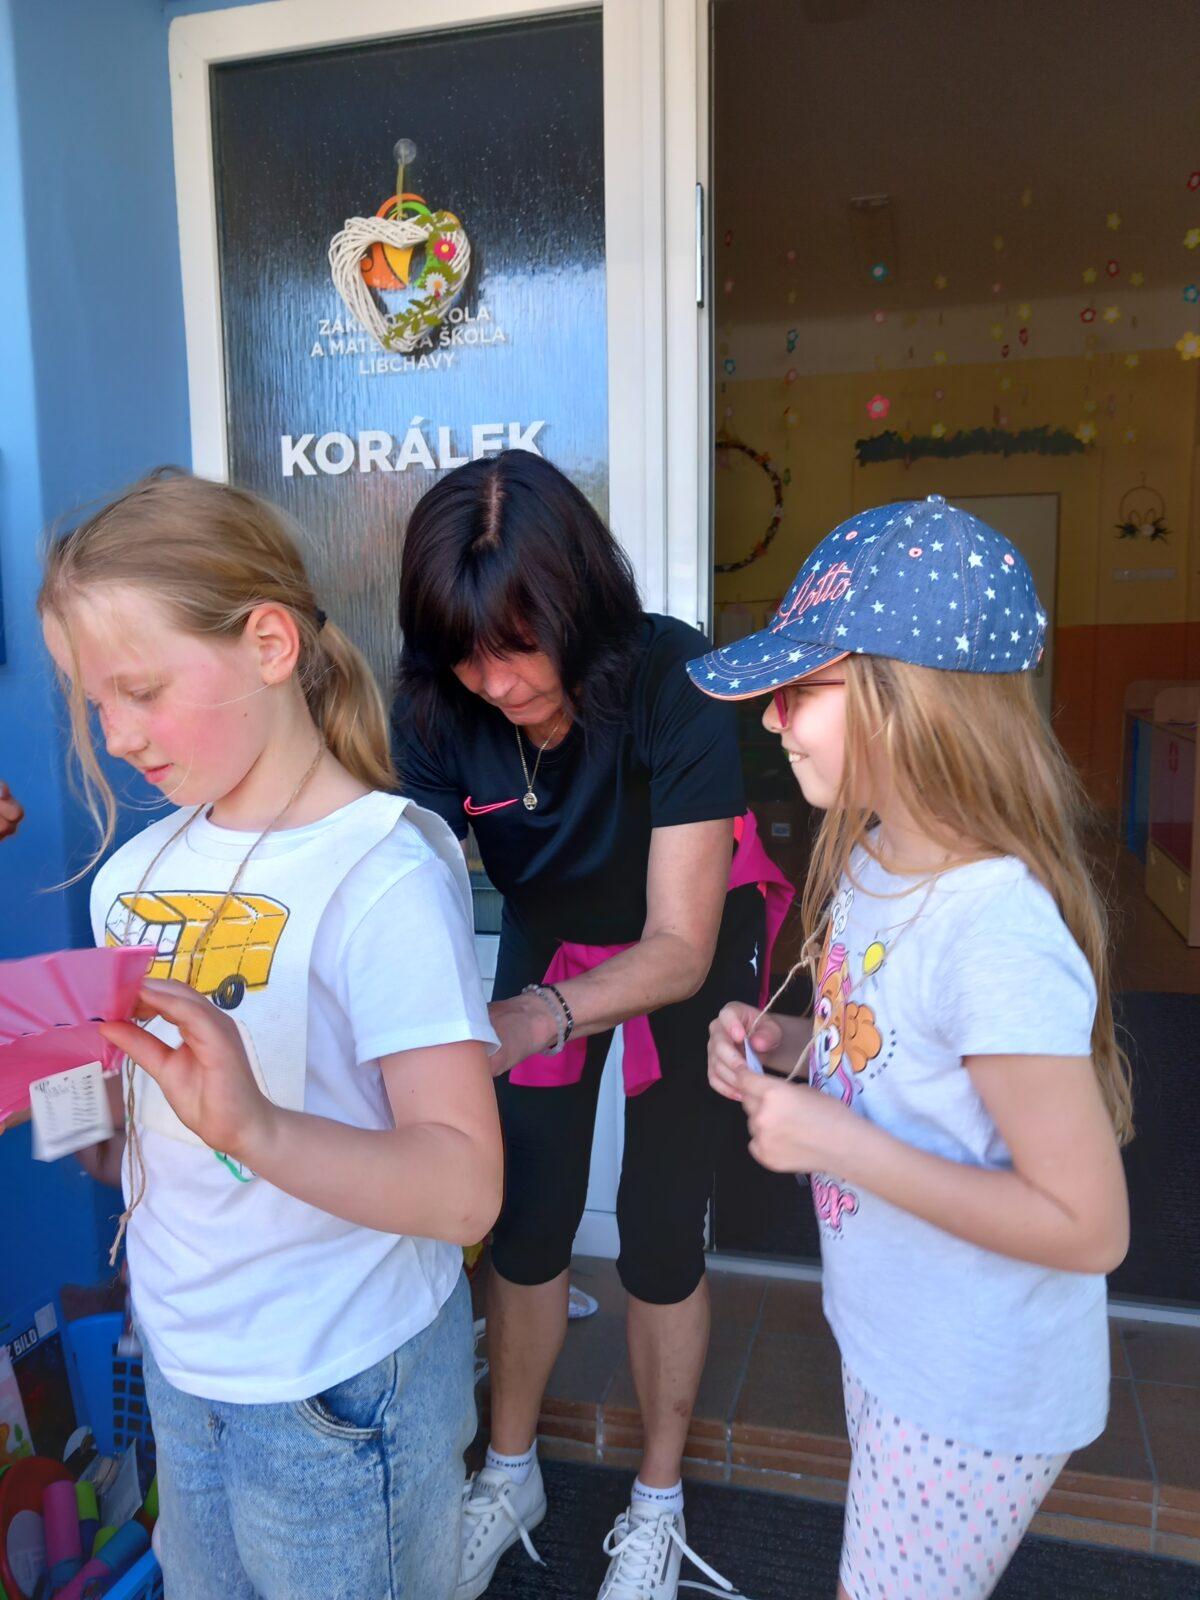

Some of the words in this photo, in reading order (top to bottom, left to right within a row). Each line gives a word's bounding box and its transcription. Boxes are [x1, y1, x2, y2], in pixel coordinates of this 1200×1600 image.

[310, 341, 324, 357] A
[439, 326, 506, 347] ŠKOLA
[359, 351, 455, 375] LIBCHAVY
[281, 415, 546, 477] KORÁLEK
